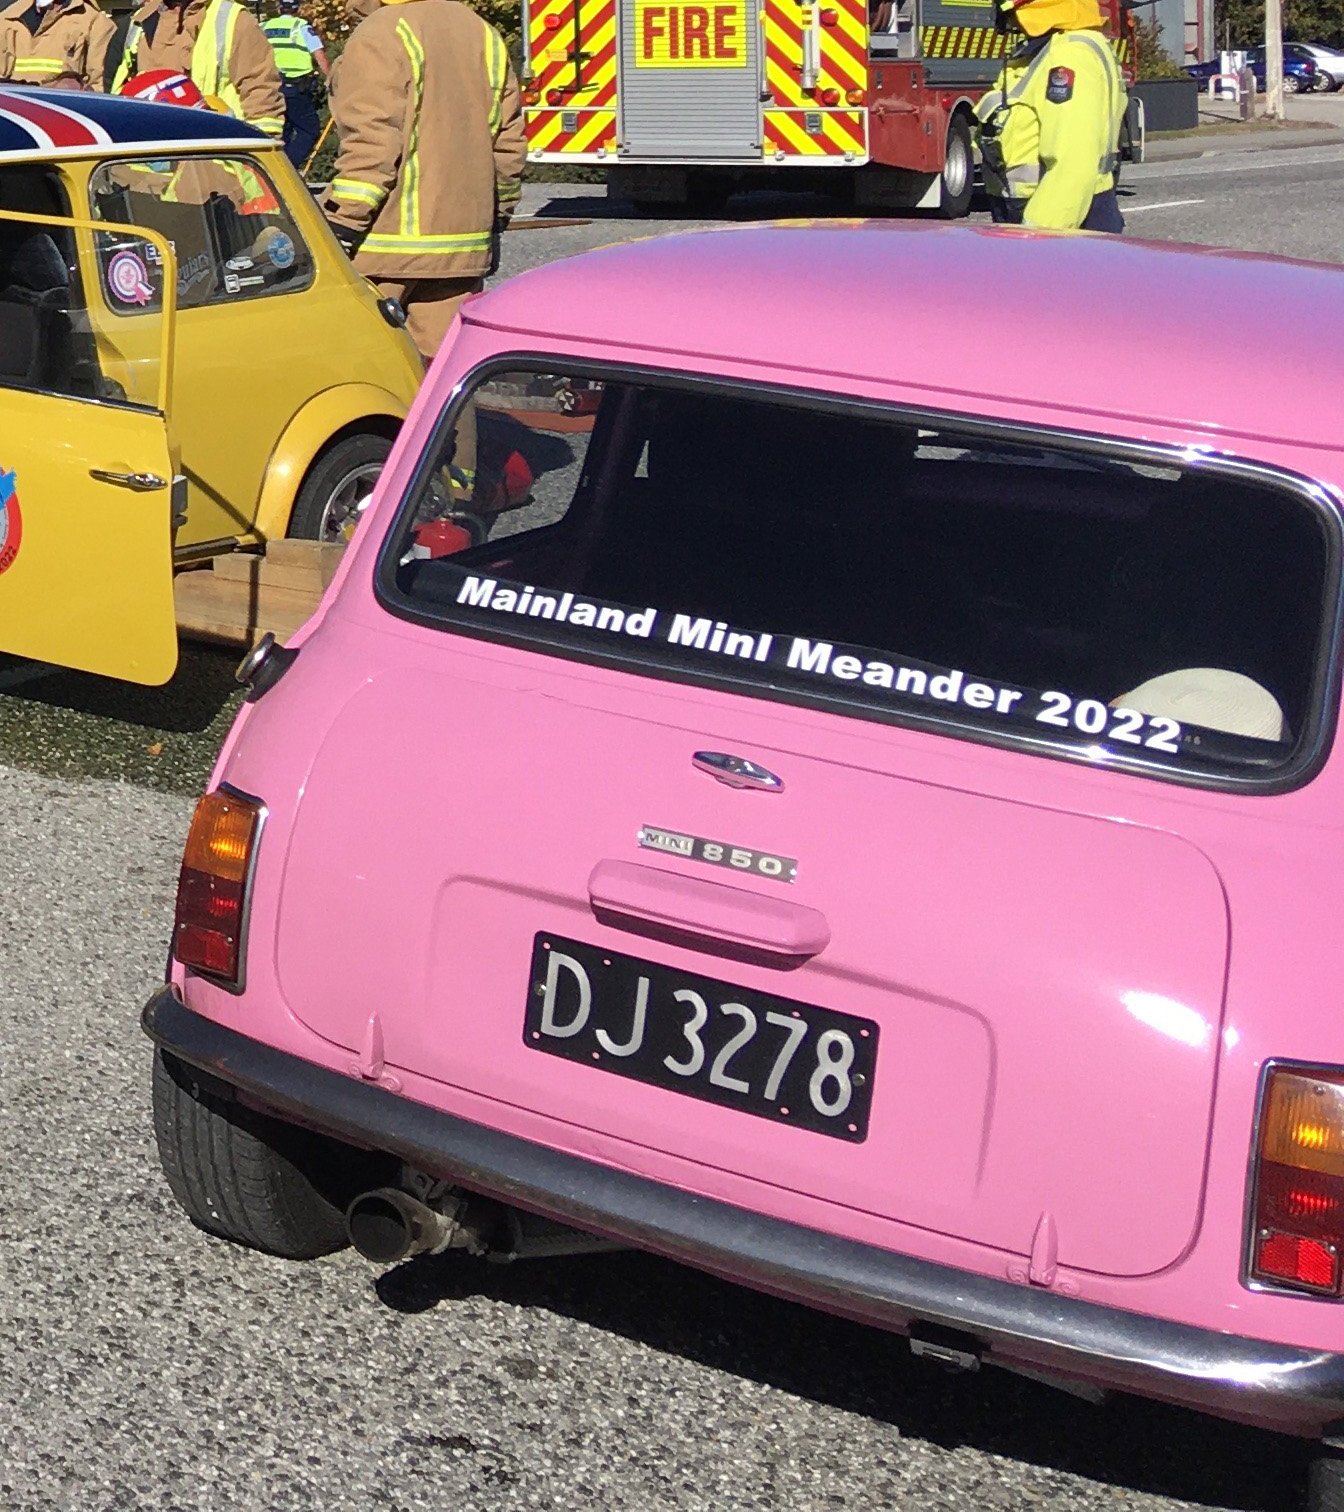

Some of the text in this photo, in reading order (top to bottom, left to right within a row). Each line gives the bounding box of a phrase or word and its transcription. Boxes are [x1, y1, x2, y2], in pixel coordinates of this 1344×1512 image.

[643, 6, 737, 59] FIRE
[457, 576, 657, 638] Mainland
[786, 637, 1024, 715] Meander
[1035, 691, 1181, 754] 2022
[644, 832, 782, 875] MINI 850
